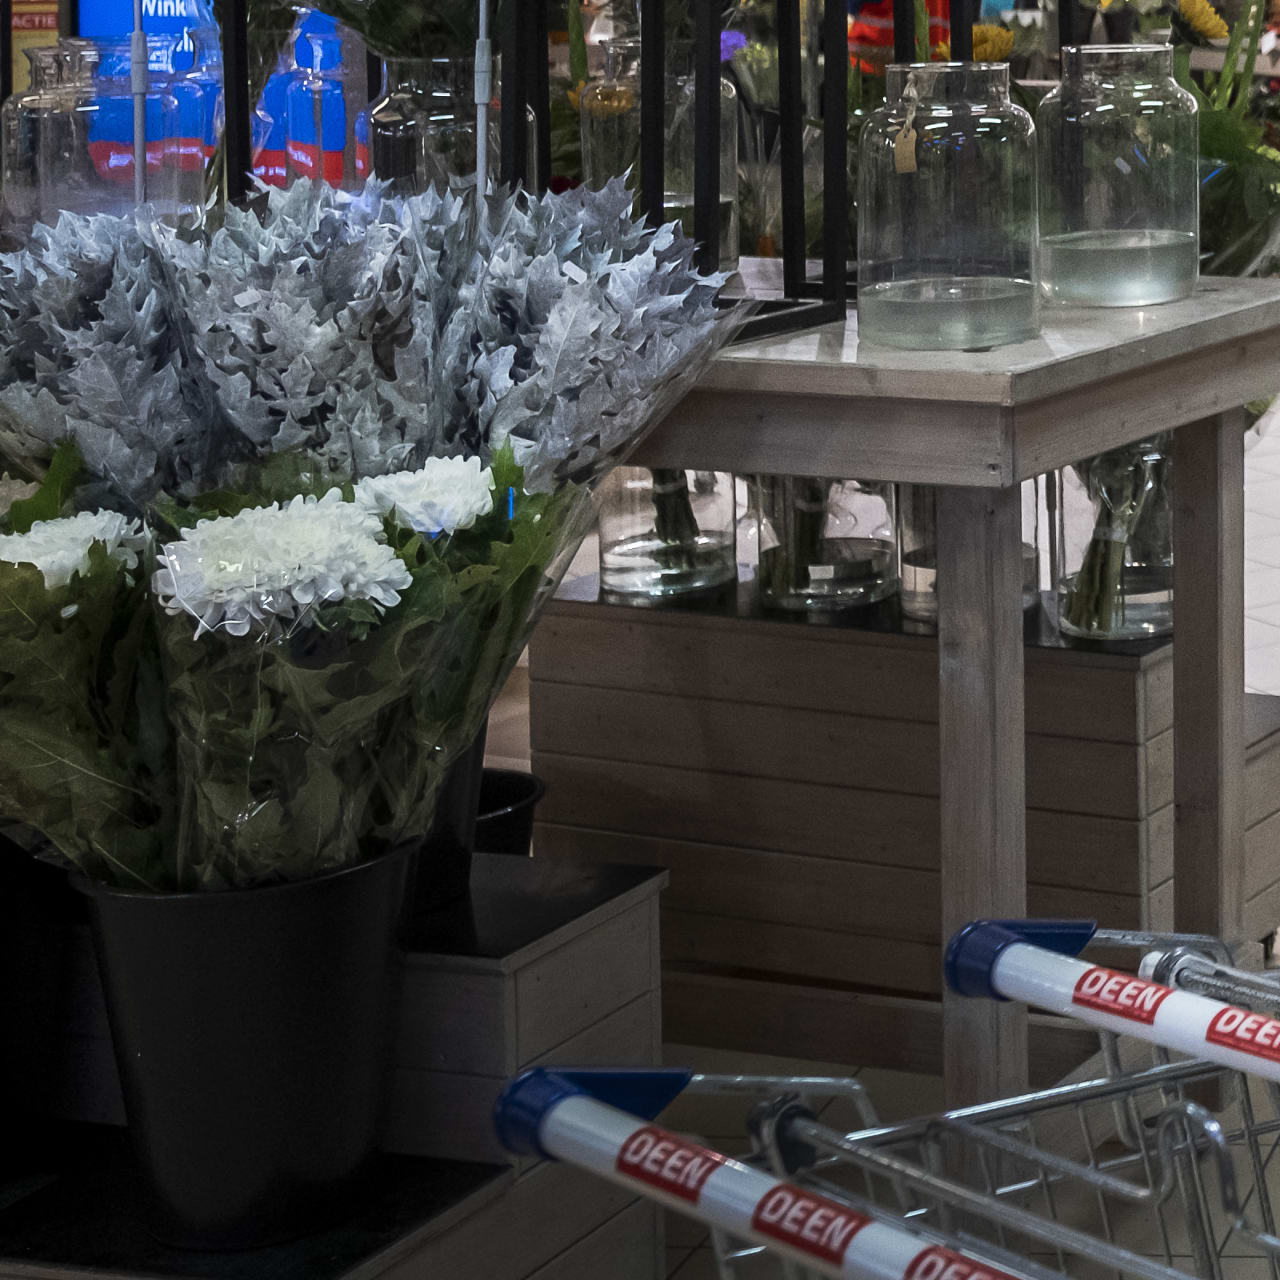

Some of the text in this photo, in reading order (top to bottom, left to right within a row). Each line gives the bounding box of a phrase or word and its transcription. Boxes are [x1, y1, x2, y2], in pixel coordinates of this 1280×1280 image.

[1082, 971, 1161, 1011] DEEN
[624, 1132, 712, 1189] DEEN
[760, 1190, 856, 1252] DEEN
